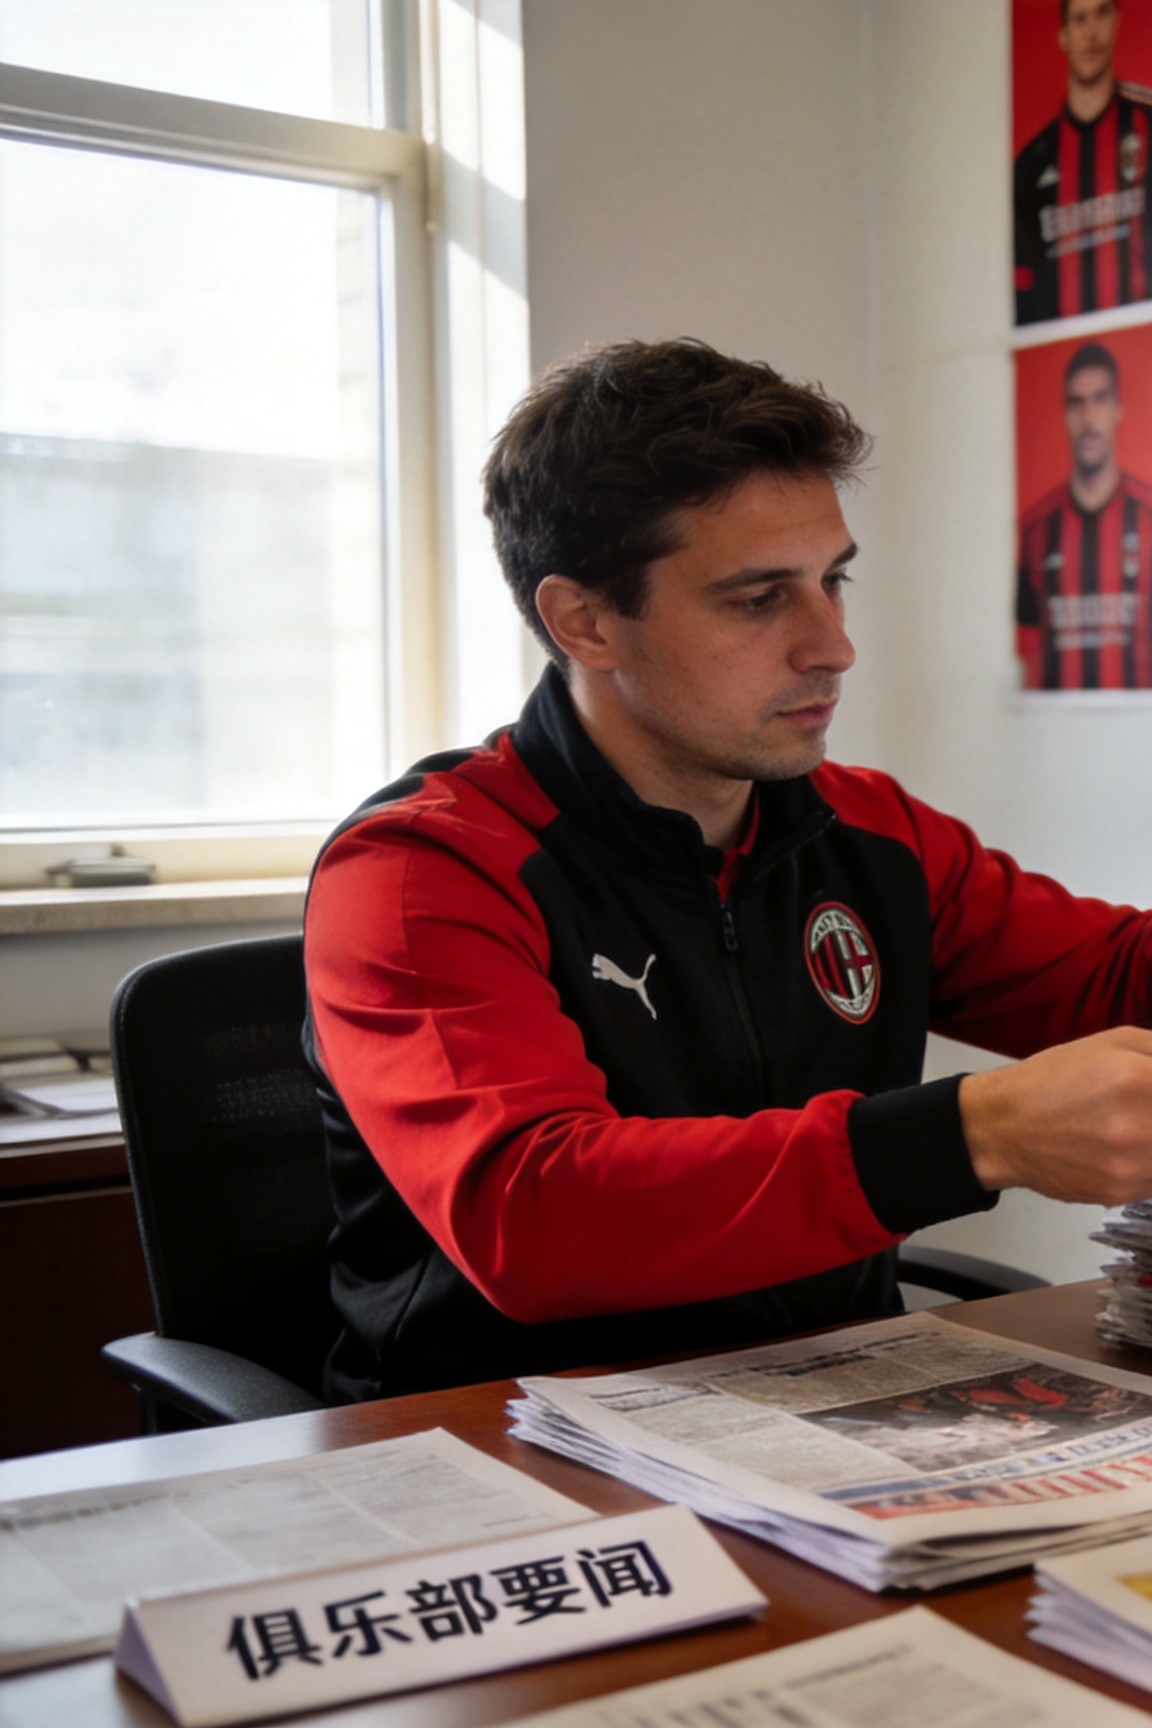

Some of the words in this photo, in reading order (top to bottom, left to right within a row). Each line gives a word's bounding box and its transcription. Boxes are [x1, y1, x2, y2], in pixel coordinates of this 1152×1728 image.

[226, 1539, 673, 1681] 俱乐部要闻
